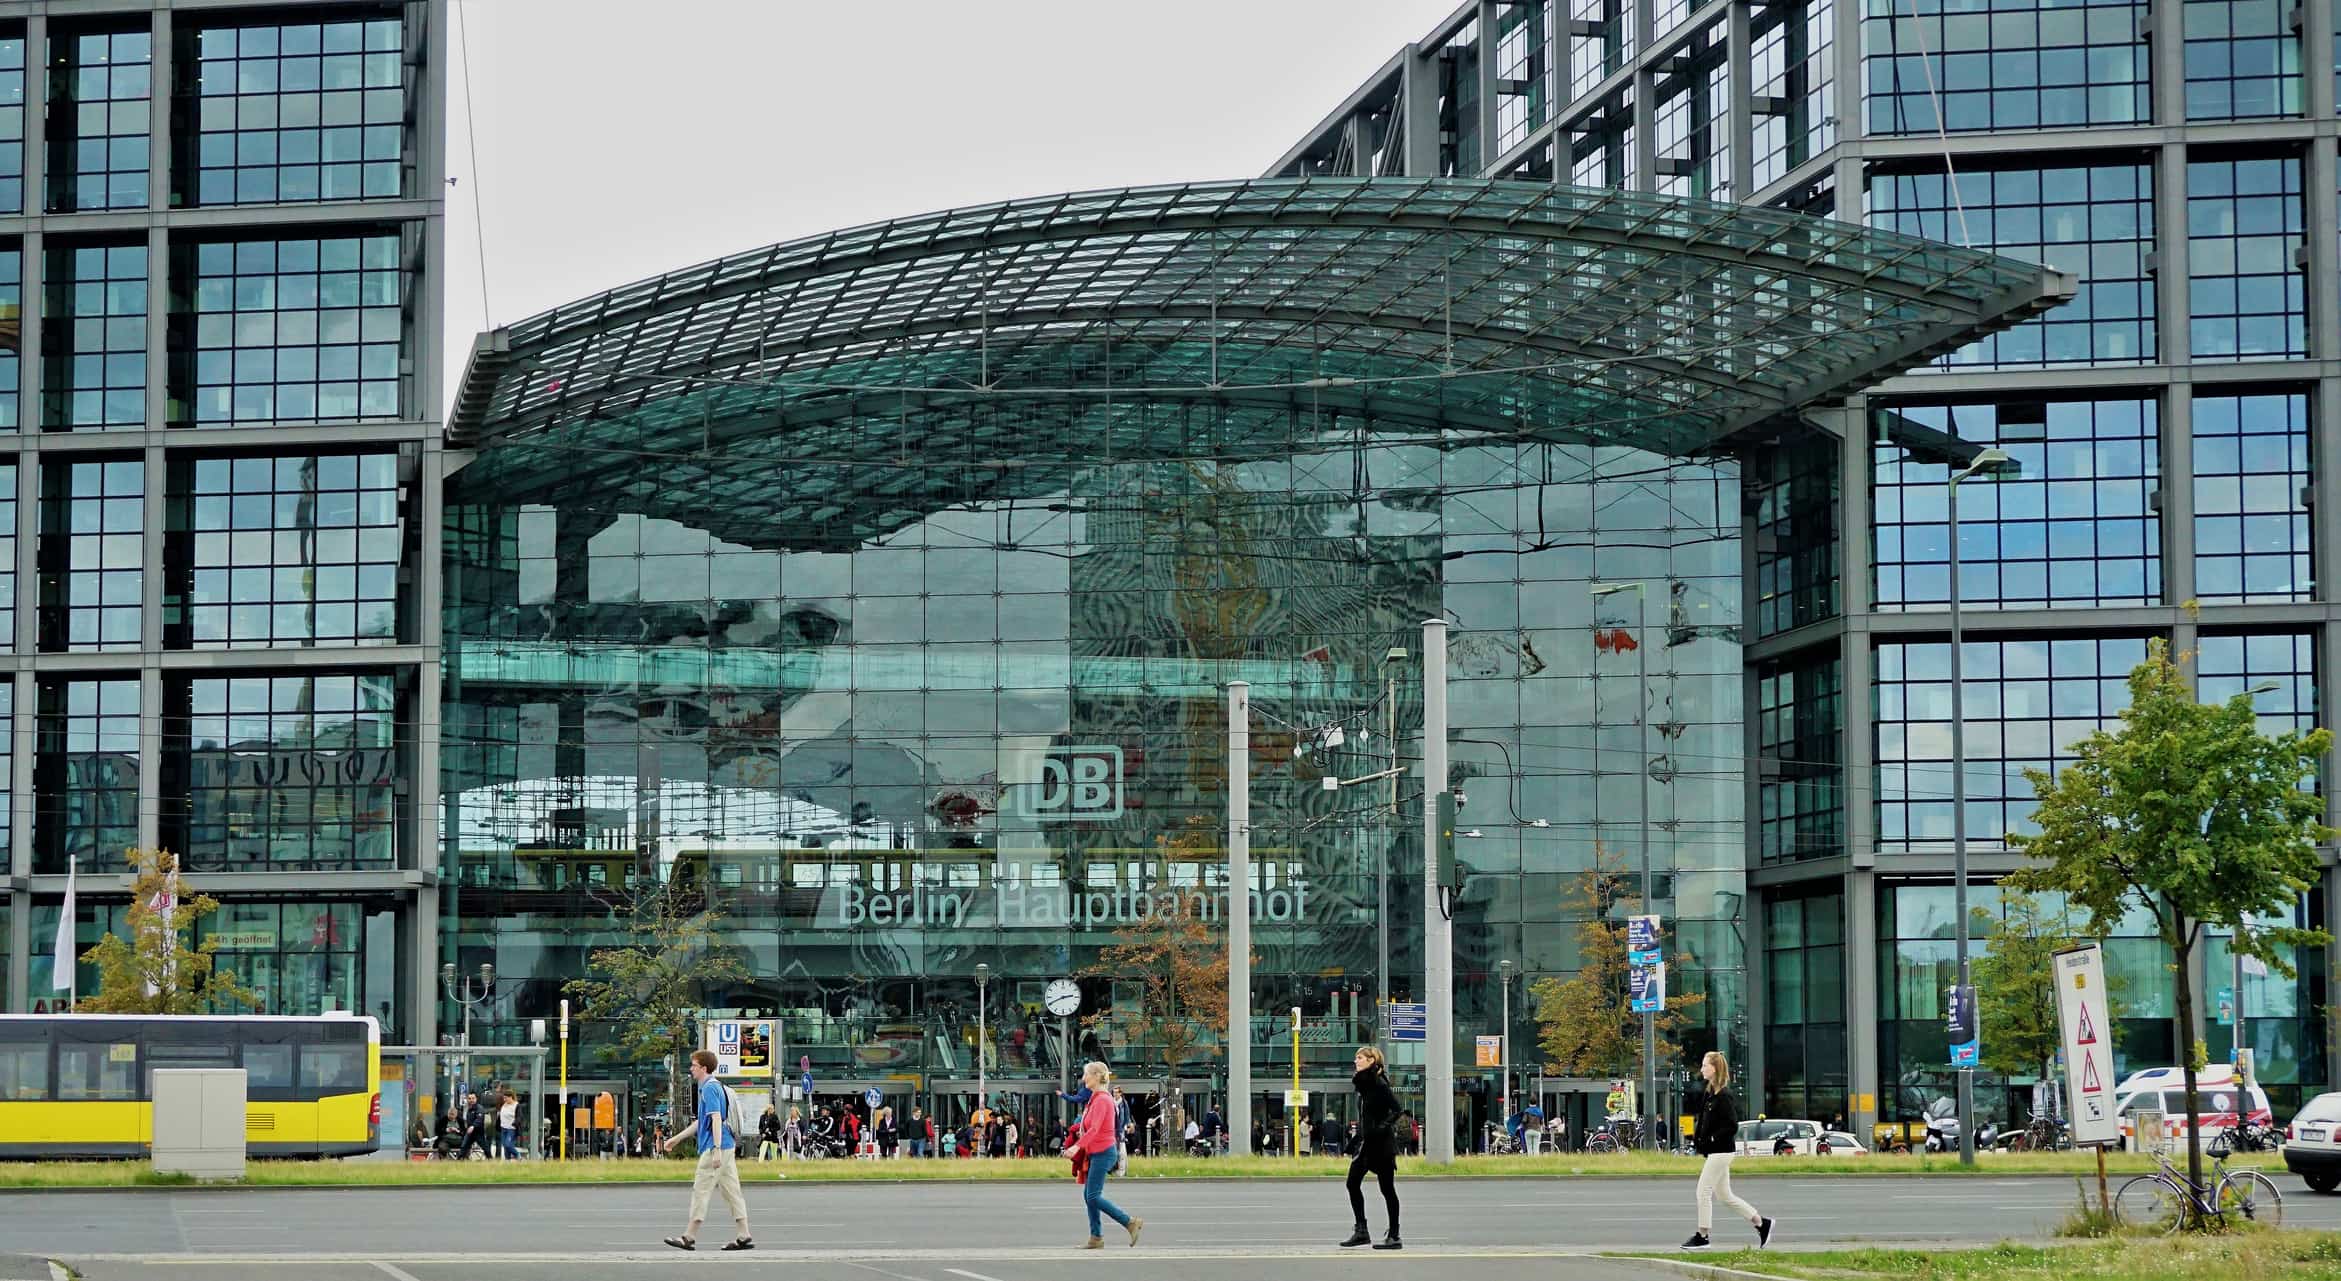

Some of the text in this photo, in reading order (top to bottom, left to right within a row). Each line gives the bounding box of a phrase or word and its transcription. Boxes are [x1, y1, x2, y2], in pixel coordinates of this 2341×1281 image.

[1032, 758, 1110, 808] DB
[839, 883, 963, 925] Berlin
[232, 935, 272, 945] geöffnet
[1352, 983, 1362, 992] 16
[721, 1024, 737, 1042] U
[720, 1044, 737, 1054] U55
